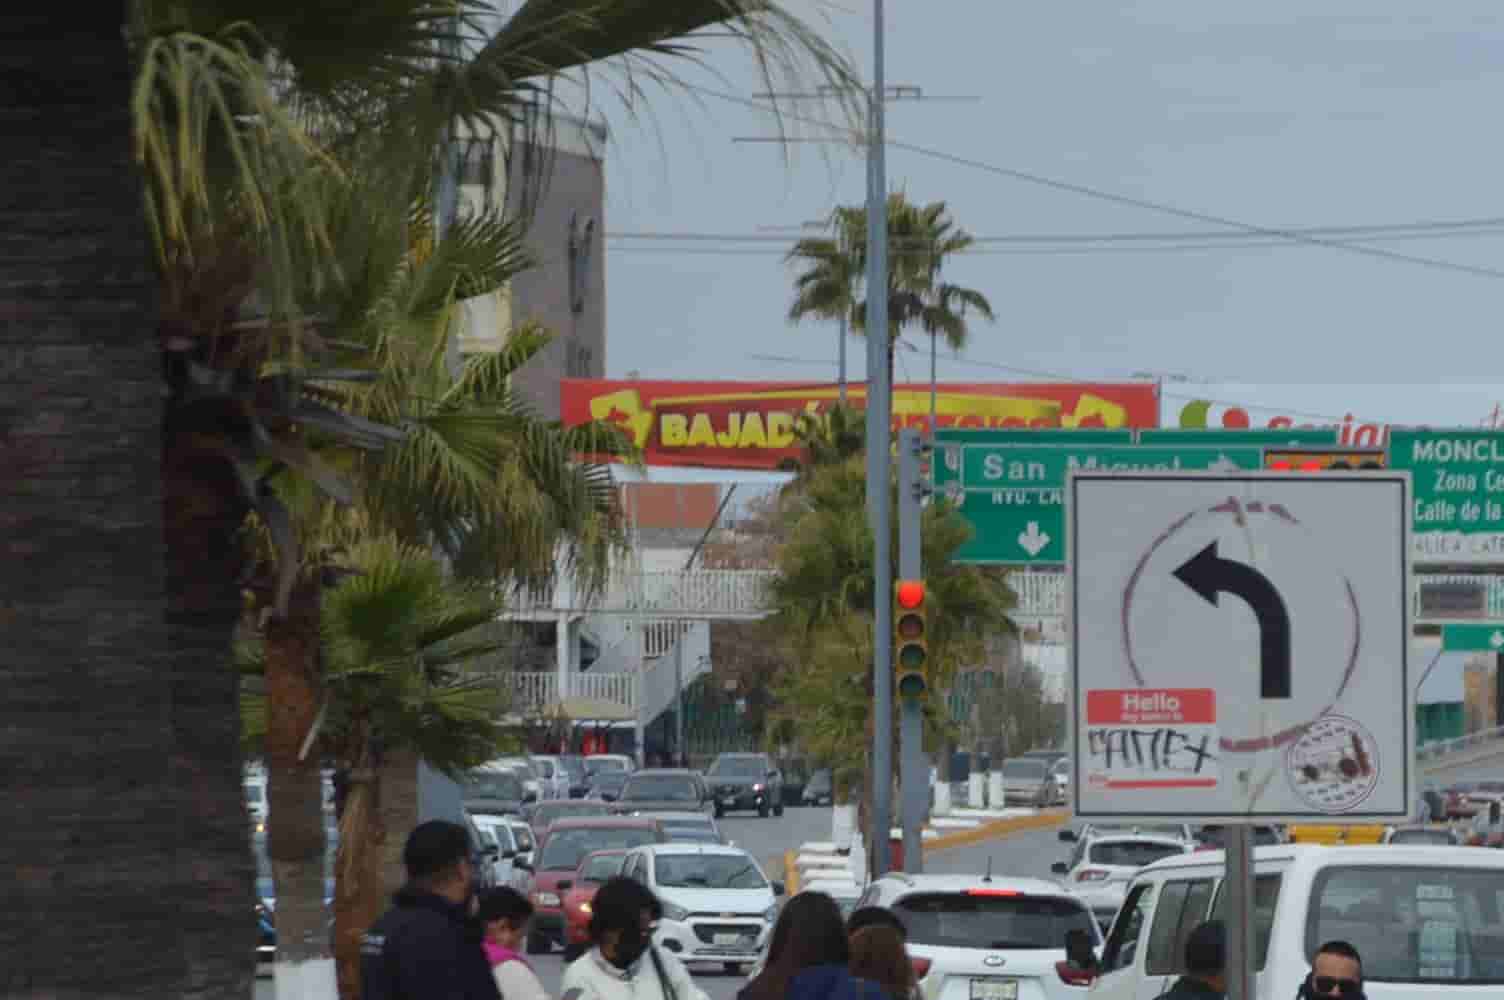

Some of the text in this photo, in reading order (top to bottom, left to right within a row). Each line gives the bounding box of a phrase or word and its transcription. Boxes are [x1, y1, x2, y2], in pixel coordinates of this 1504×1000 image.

[660, 400, 834, 447] BAJAD
[983, 453, 1047, 481] San
[1433, 469, 1477, 492] Zona
[1414, 498, 1456, 521] Calle
[1461, 498, 1481, 521] de
[1485, 498, 1501, 521] la
[1122, 691, 1181, 711] Hello
